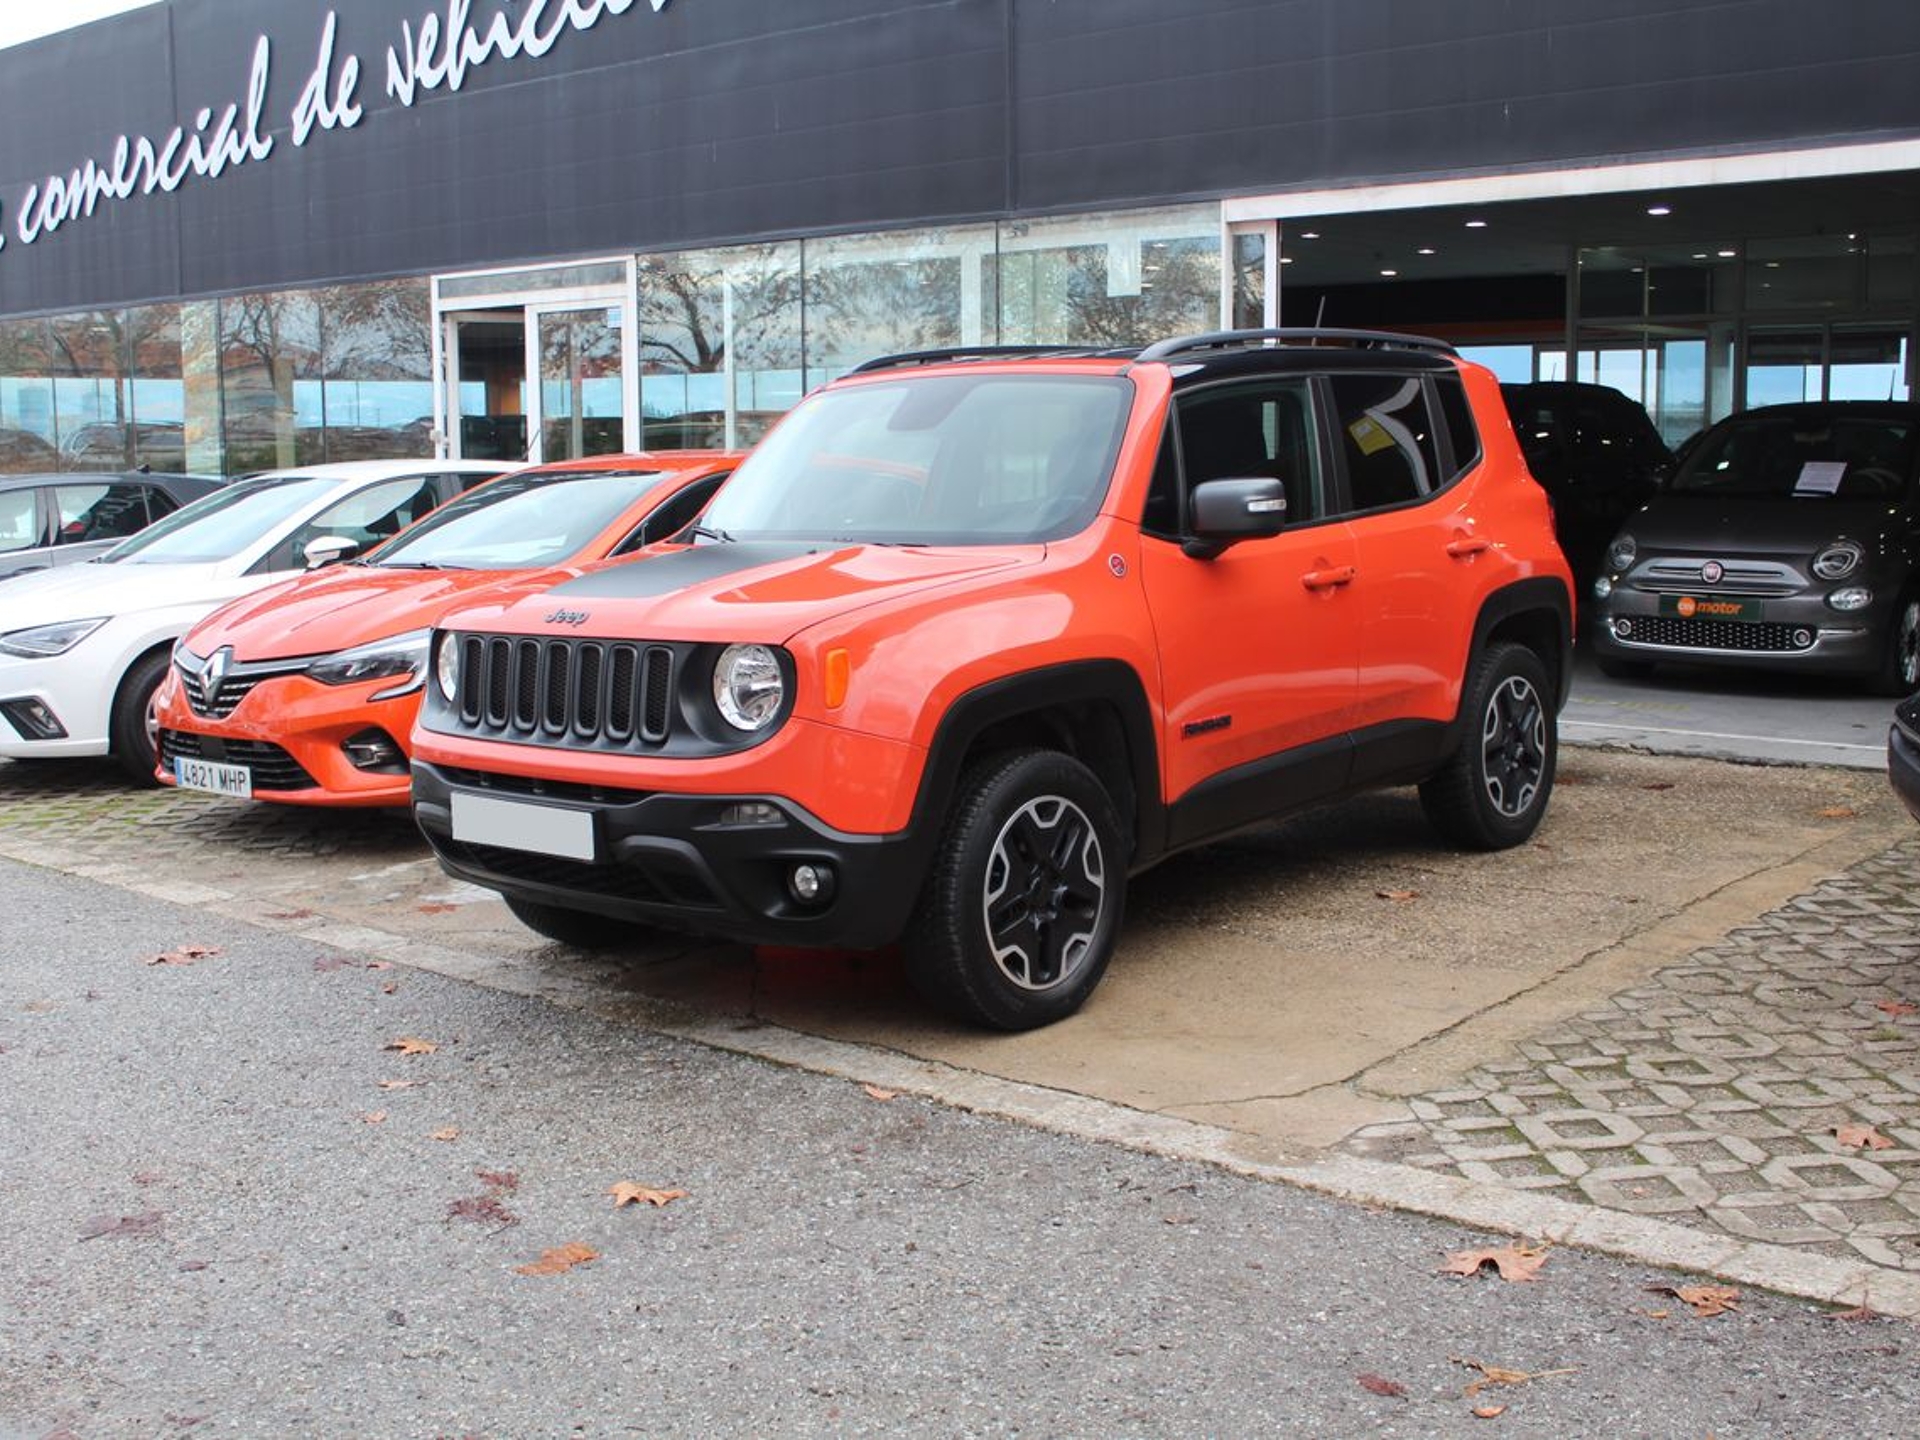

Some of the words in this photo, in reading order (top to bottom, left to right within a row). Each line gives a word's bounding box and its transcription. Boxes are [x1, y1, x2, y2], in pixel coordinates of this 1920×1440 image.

[18, 37, 272, 243] comercial
[291, 10, 362, 146] de
[545, 608, 591, 628] Jeep
[1697, 602, 1744, 615] motor
[183, 762, 213, 789] 4821
[219, 769, 247, 793] MHP
